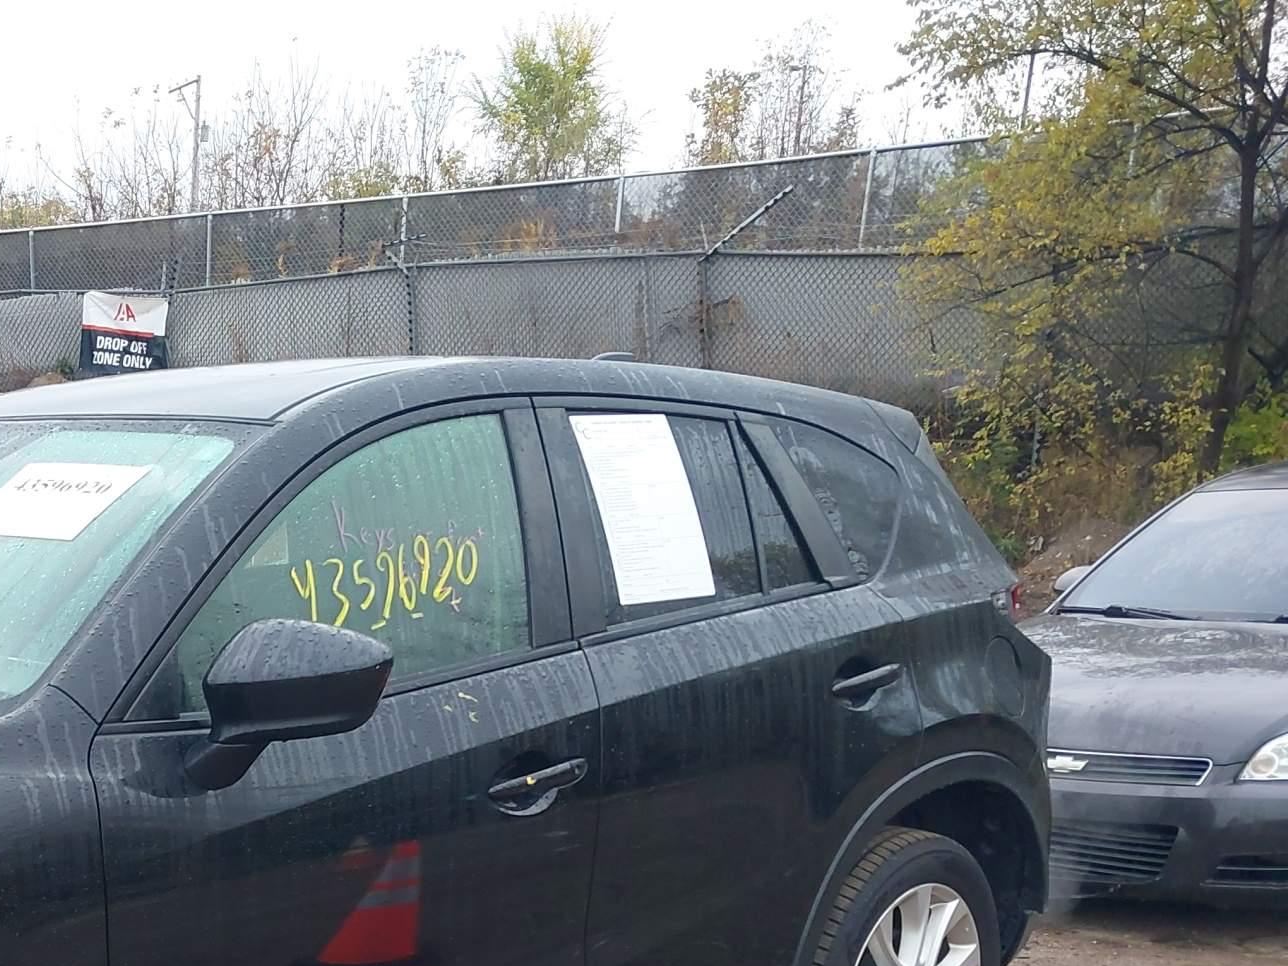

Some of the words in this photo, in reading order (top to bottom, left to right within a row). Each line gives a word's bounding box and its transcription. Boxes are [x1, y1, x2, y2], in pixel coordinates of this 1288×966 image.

[96, 335, 129, 351] DROP
[130, 340, 148, 355] OFF
[92, 351, 121, 366] ZONE
[122, 354, 153, 369] ONLY
[331, 499, 396, 554] Keys
